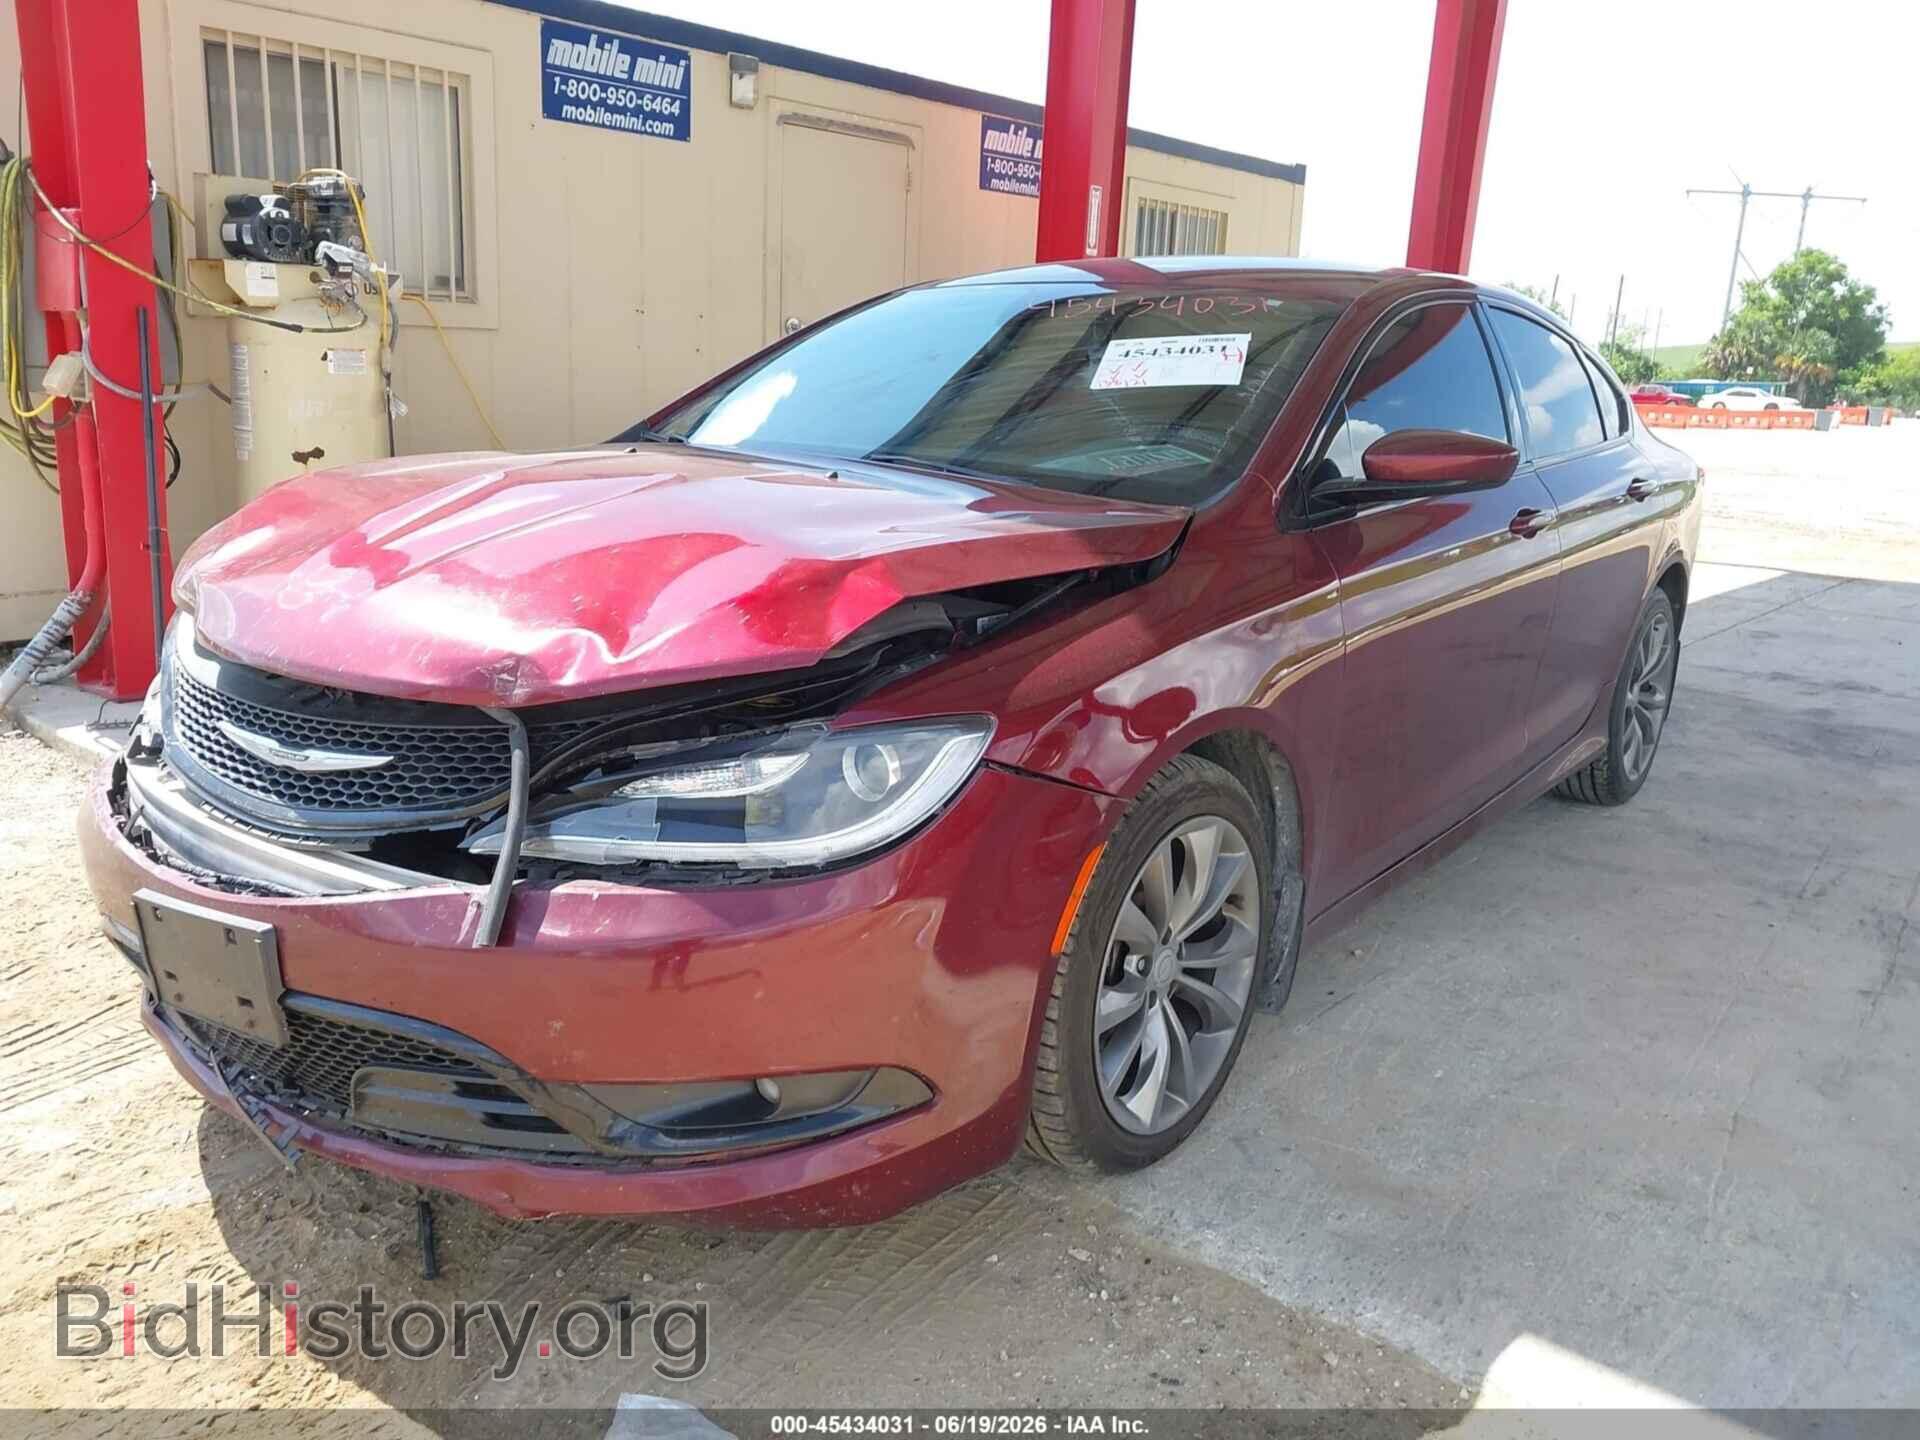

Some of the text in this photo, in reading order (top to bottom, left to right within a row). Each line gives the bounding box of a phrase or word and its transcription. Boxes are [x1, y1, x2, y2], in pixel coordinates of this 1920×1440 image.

[547, 34, 687, 90] mobile mini
[553, 76, 681, 117] 1-800-950-6464
[562, 104, 674, 136] mobilemini.com
[983, 124, 1034, 158] mobile
[987, 157, 1042, 180] 1-800-950-
[990, 178, 1041, 194] mobilemini.
